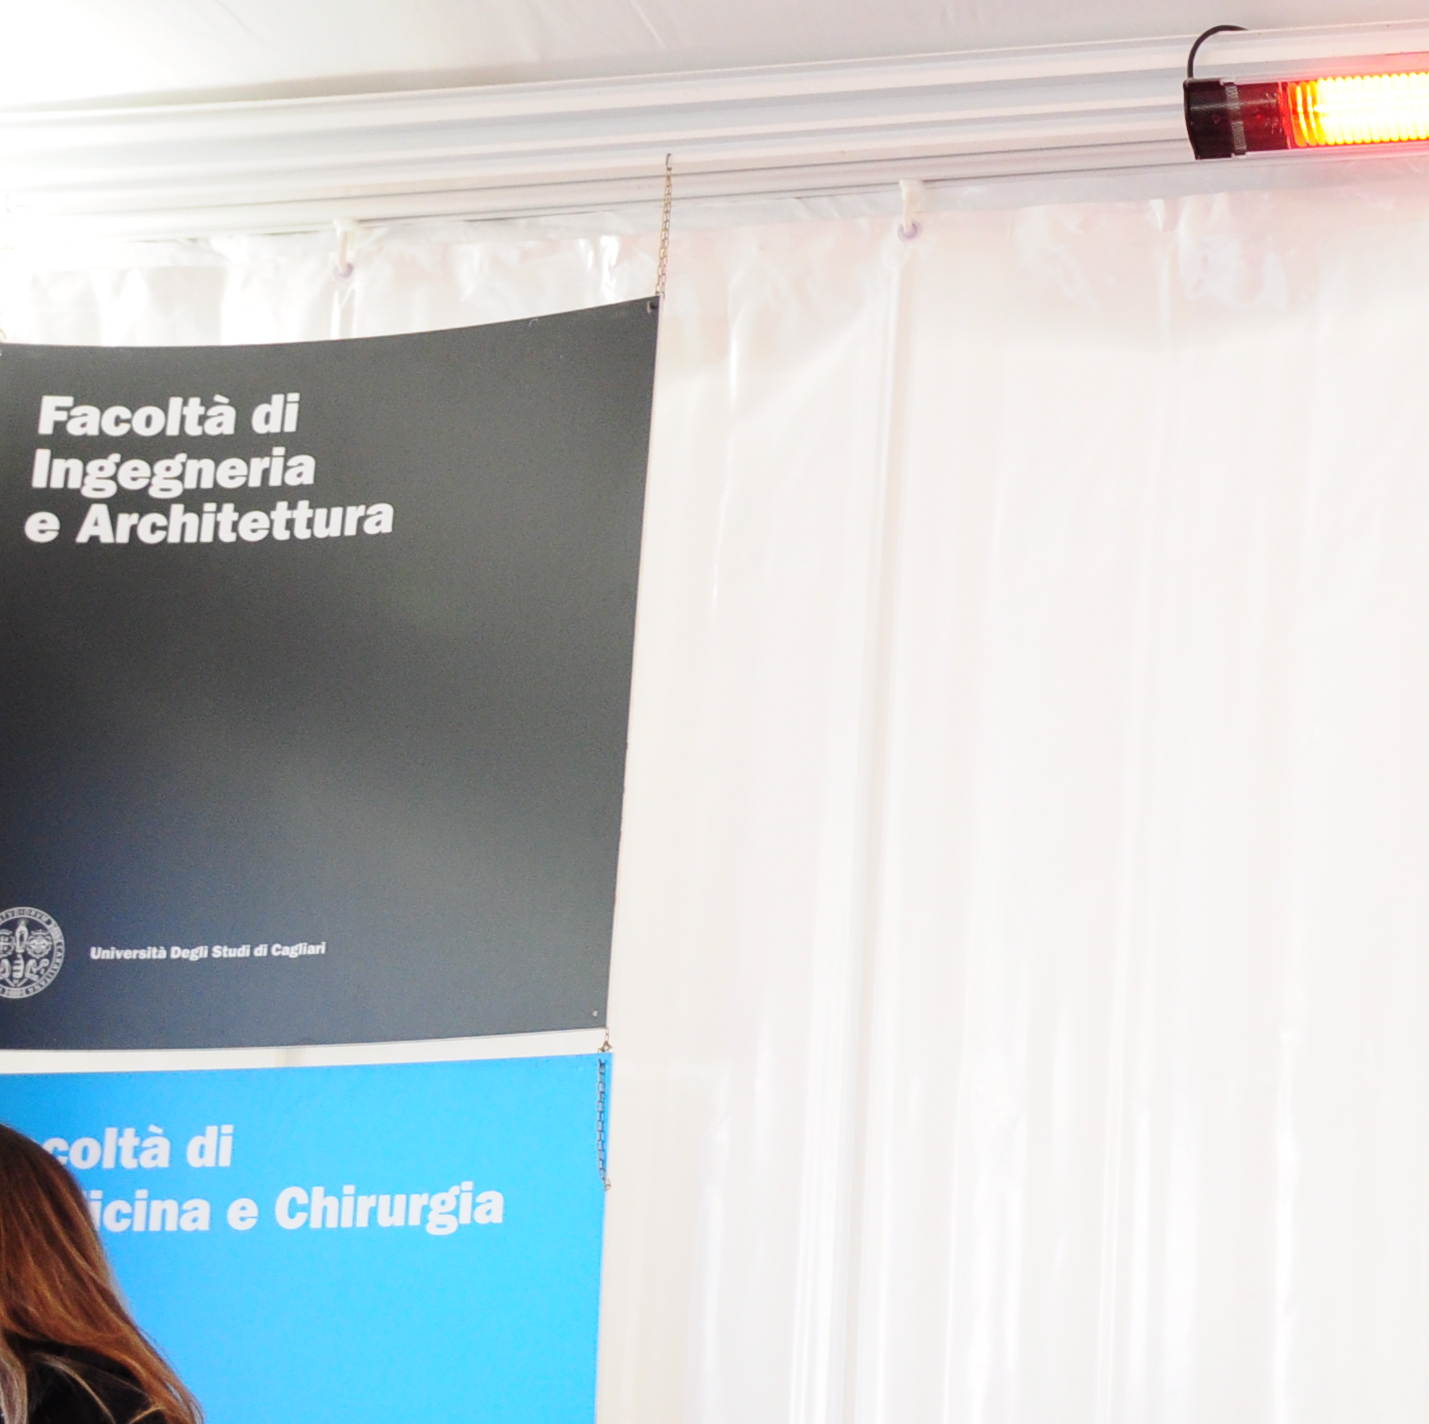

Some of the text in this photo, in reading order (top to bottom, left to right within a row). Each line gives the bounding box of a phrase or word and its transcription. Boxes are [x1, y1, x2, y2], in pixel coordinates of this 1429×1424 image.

[38, 392, 300, 437] Facoltà di
[31, 446, 316, 499] Ingegneria
[24, 501, 394, 544] e Architettura
[90, 941, 326, 962] Università Degli Studi di Cagliari
[42, 1124, 234, 1170] coltà di
[88, 1181, 504, 1236] icina e Chirurgia
